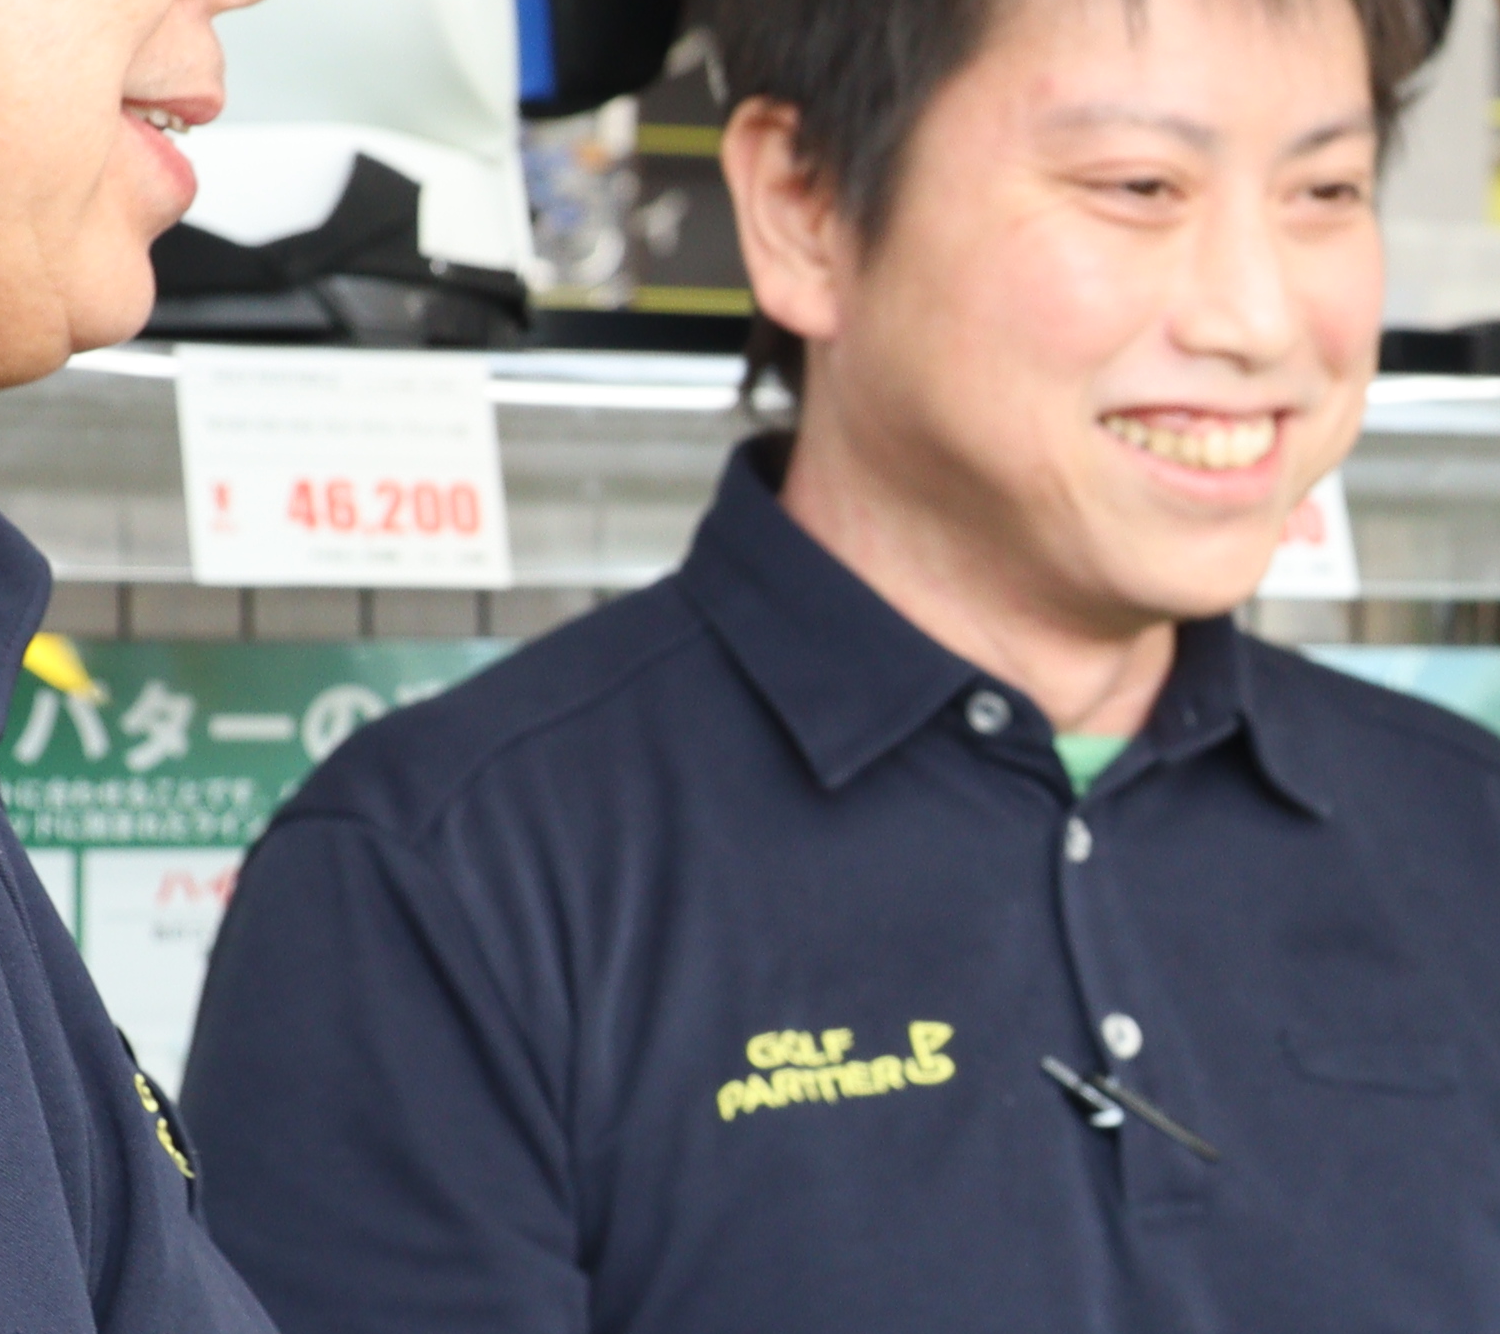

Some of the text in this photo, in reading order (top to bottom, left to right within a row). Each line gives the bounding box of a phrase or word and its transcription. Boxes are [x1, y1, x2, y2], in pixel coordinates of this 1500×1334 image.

[287, 478, 481, 537] 46,200
[12, 677, 446, 771] パターの
[746, 1027, 854, 1069] GOLF
[716, 1054, 906, 1122] PARTNER
